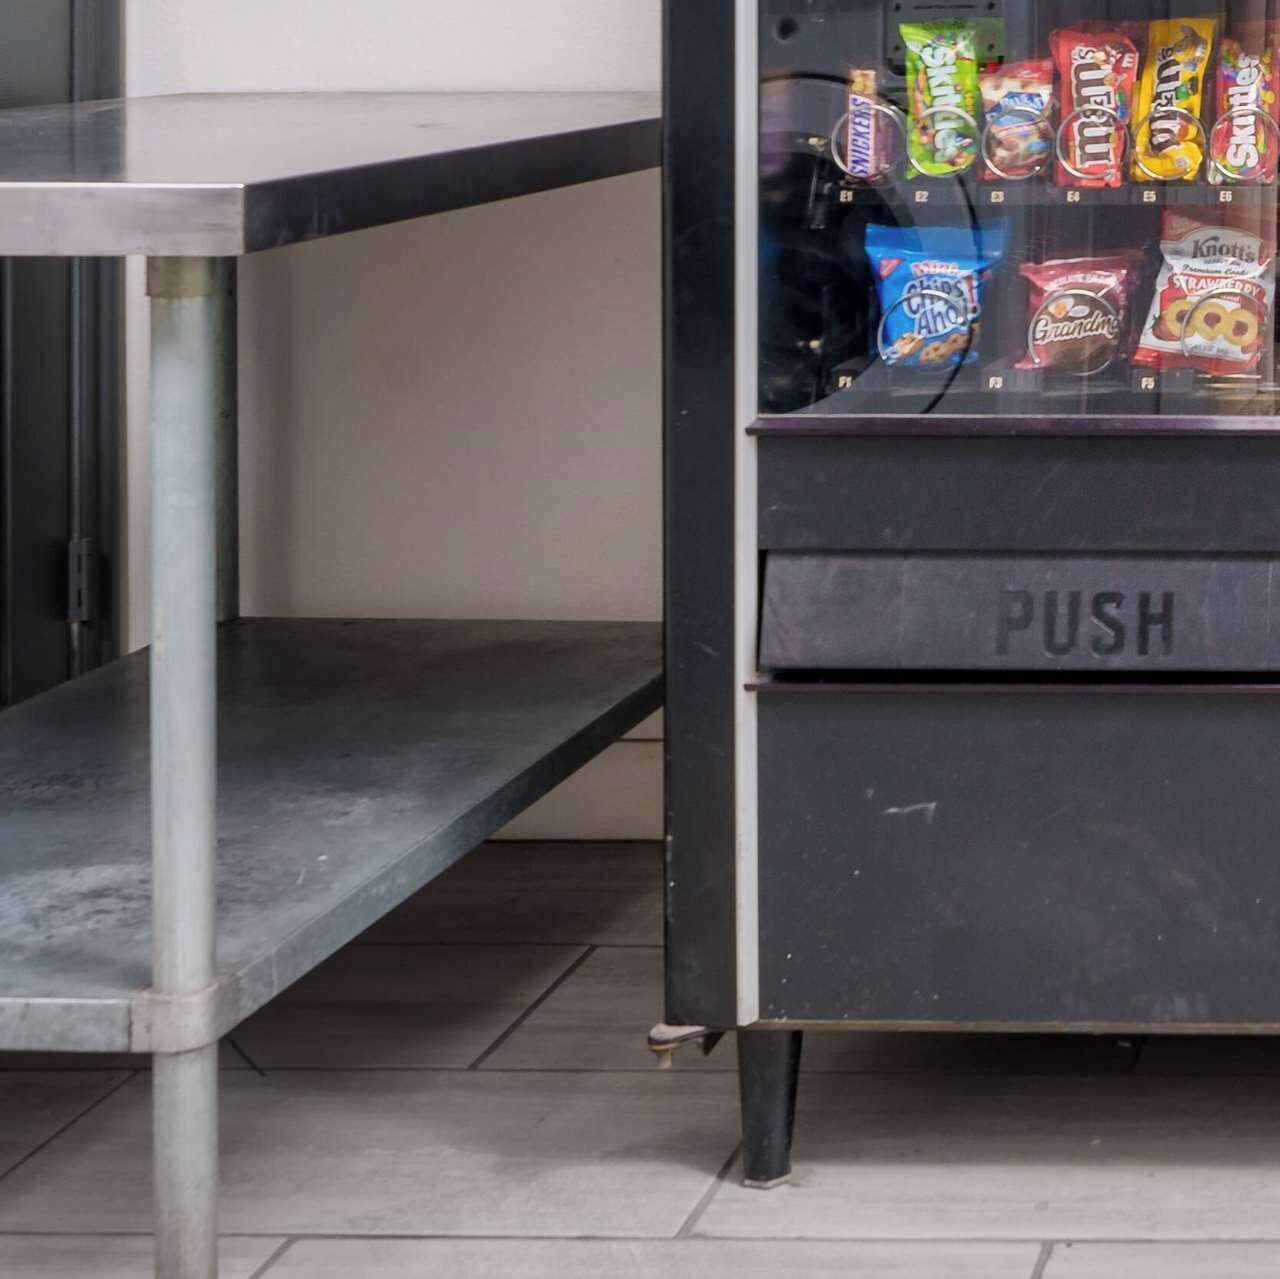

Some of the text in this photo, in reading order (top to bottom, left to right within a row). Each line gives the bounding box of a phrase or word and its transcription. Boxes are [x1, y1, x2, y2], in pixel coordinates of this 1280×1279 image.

[850, 96, 872, 177] SNICKERS
[1226, 53, 1261, 168] Skittles
[1192, 236, 1256, 263] Knott's
[996, 590, 1175, 658] PUSH
